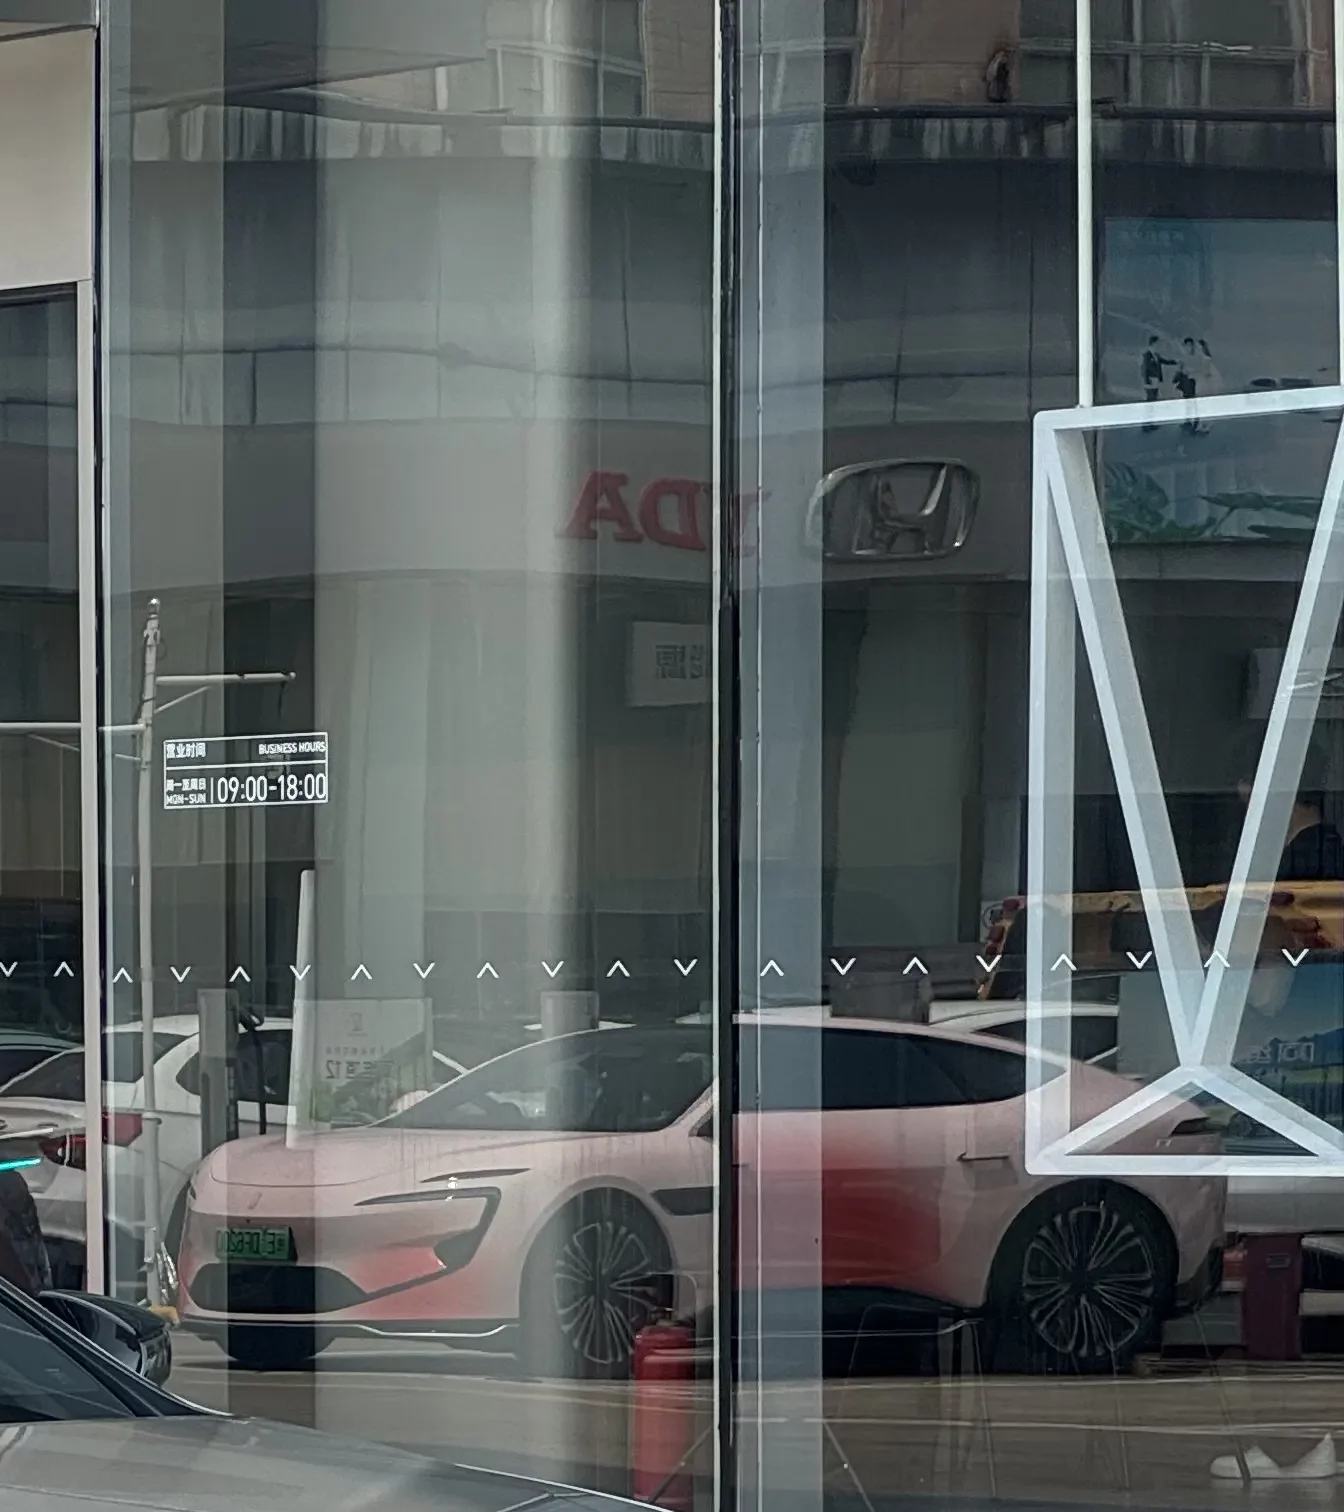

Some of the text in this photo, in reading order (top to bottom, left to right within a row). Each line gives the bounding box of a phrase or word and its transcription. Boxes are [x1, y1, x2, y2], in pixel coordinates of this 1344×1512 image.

[166, 742, 206, 759] 营业时间
[258, 741, 326, 755] BUSINESS HOURS
[217, 773, 327, 803] 09:00-18:00
[166, 793, 207, 805] MON-SUN
